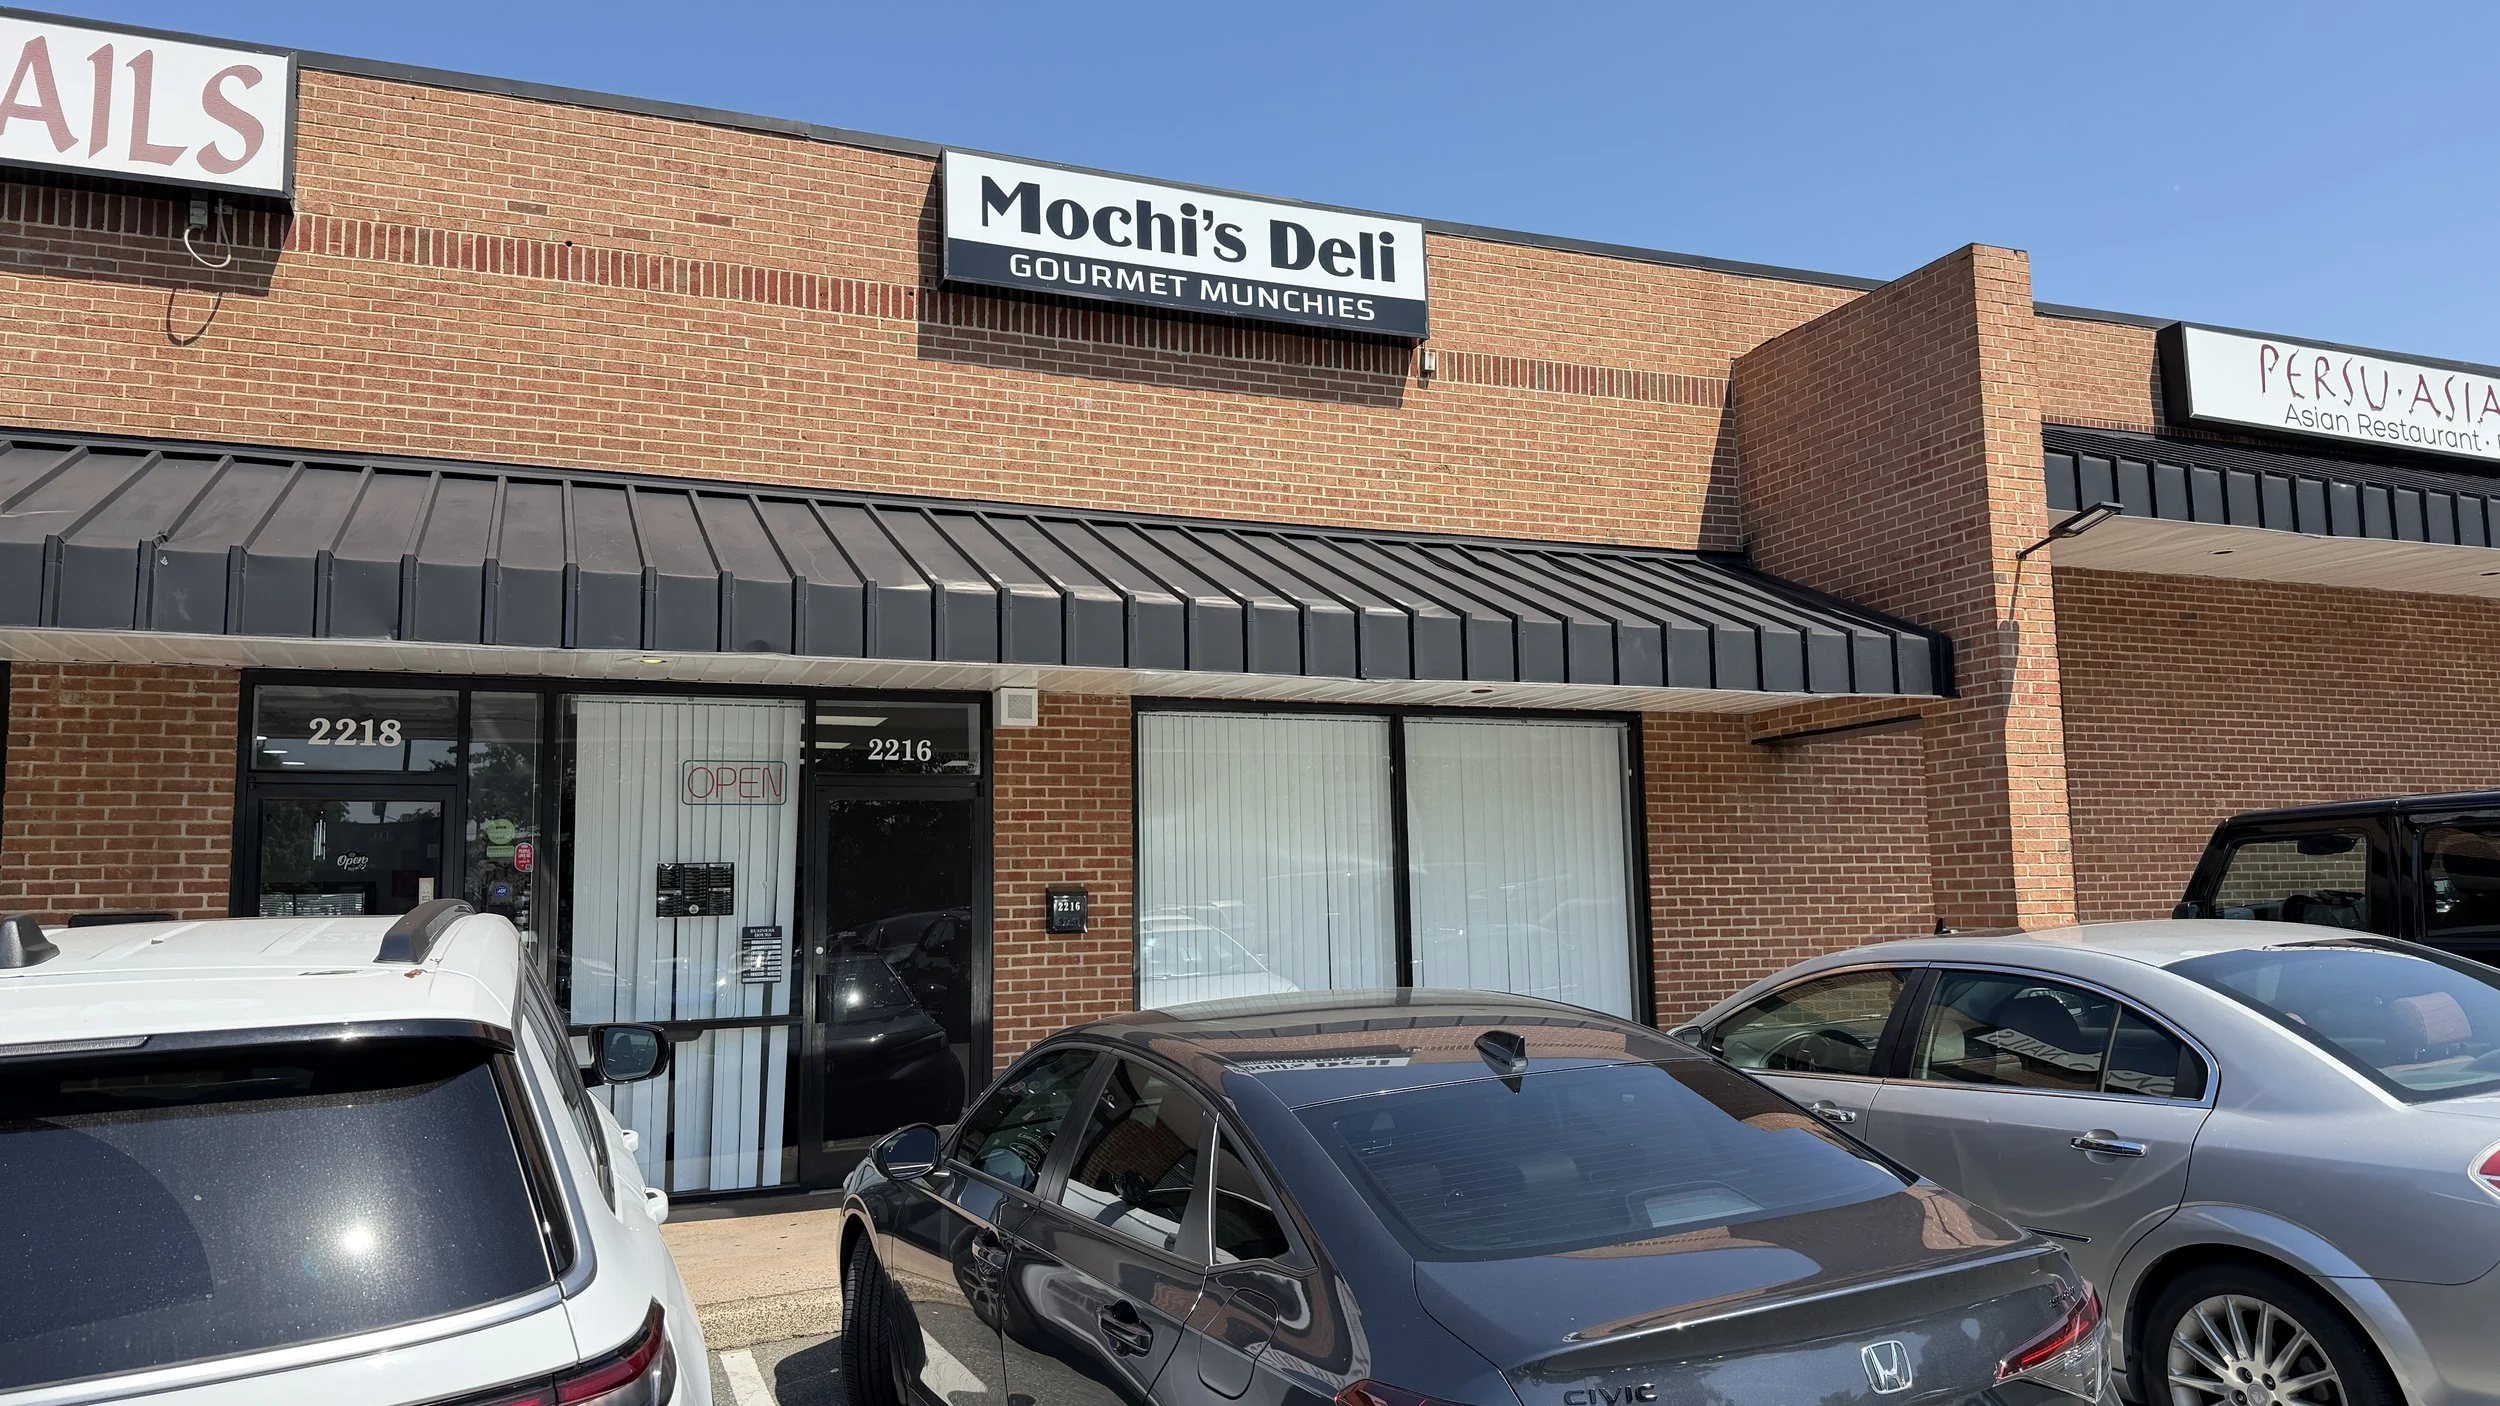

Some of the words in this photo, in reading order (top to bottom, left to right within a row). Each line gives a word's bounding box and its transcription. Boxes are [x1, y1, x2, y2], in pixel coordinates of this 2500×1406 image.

[0, 35, 264, 174] AILS
[981, 175, 1247, 263] Mochi's
[1270, 219, 1395, 283] Deli
[1010, 253, 1187, 297] GOURMET
[1200, 279, 1375, 321] MUNCHIES
[2284, 403, 2350, 433] Asian
[2358, 413, 2482, 451] Restaurant
[308, 717, 402, 747] 2218
[868, 738, 932, 761] 2216
[687, 766, 783, 799] OPEN
[337, 855, 369, 870] Open
[1058, 901, 1081, 911] 2216
[1563, 1383, 1658, 1405] CIVIC
